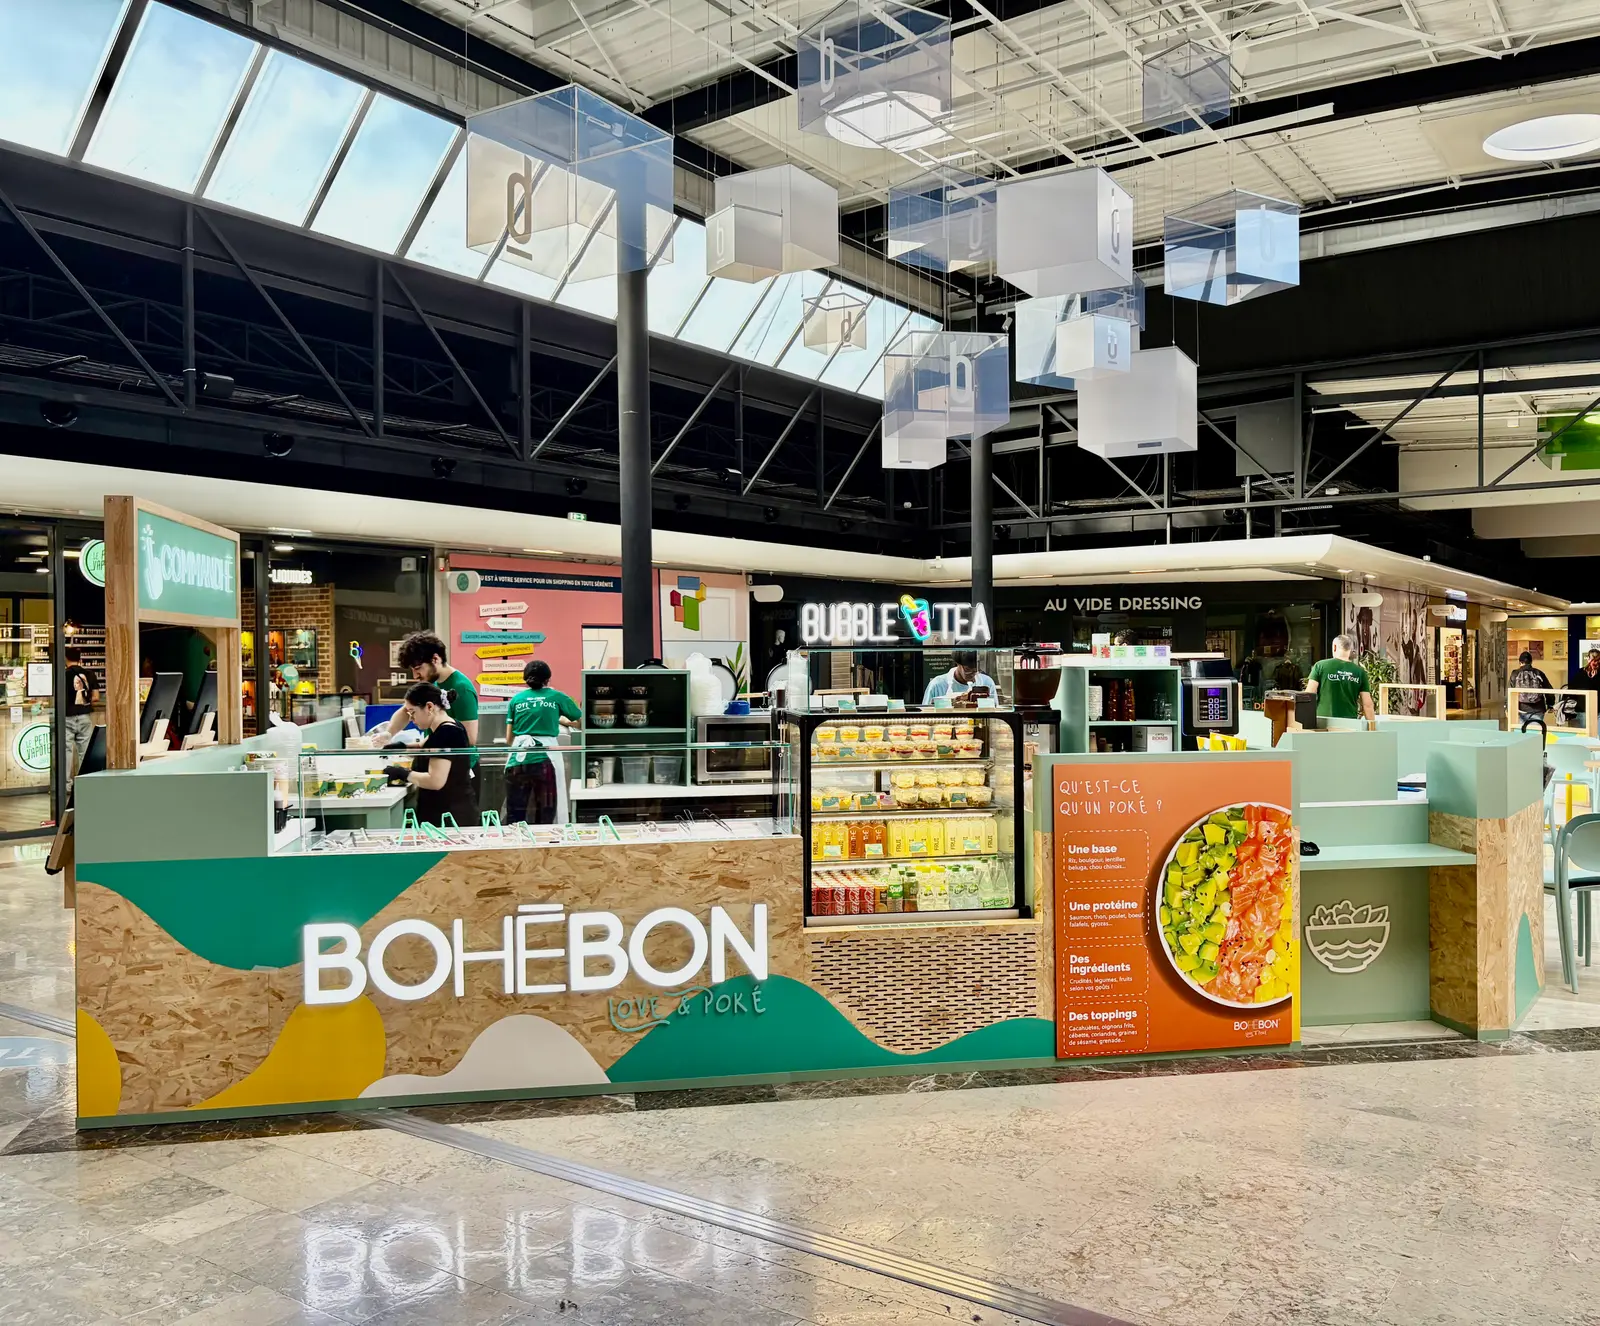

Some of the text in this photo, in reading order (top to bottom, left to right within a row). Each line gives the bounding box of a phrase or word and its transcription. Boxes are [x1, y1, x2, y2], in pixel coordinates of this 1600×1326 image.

[1044, 596, 1203, 612] AU VIDE DRESSING
[802, 602, 991, 643] BUBBLE TEA
[1059, 779, 1141, 796] QU'EST-CE
[1059, 795, 1162, 816] QU'UN POKÉ ?
[1068, 843, 1118, 854] Une base
[1069, 899, 1138, 913] Une protéine
[1069, 954, 1090, 964] Des
[1069, 962, 1131, 976] ingrédients
[609, 984, 767, 1032] LOVE & POKÉ
[1068, 1009, 1138, 1022] Des toppings
[1101, 1023, 1123, 1031] oignons
